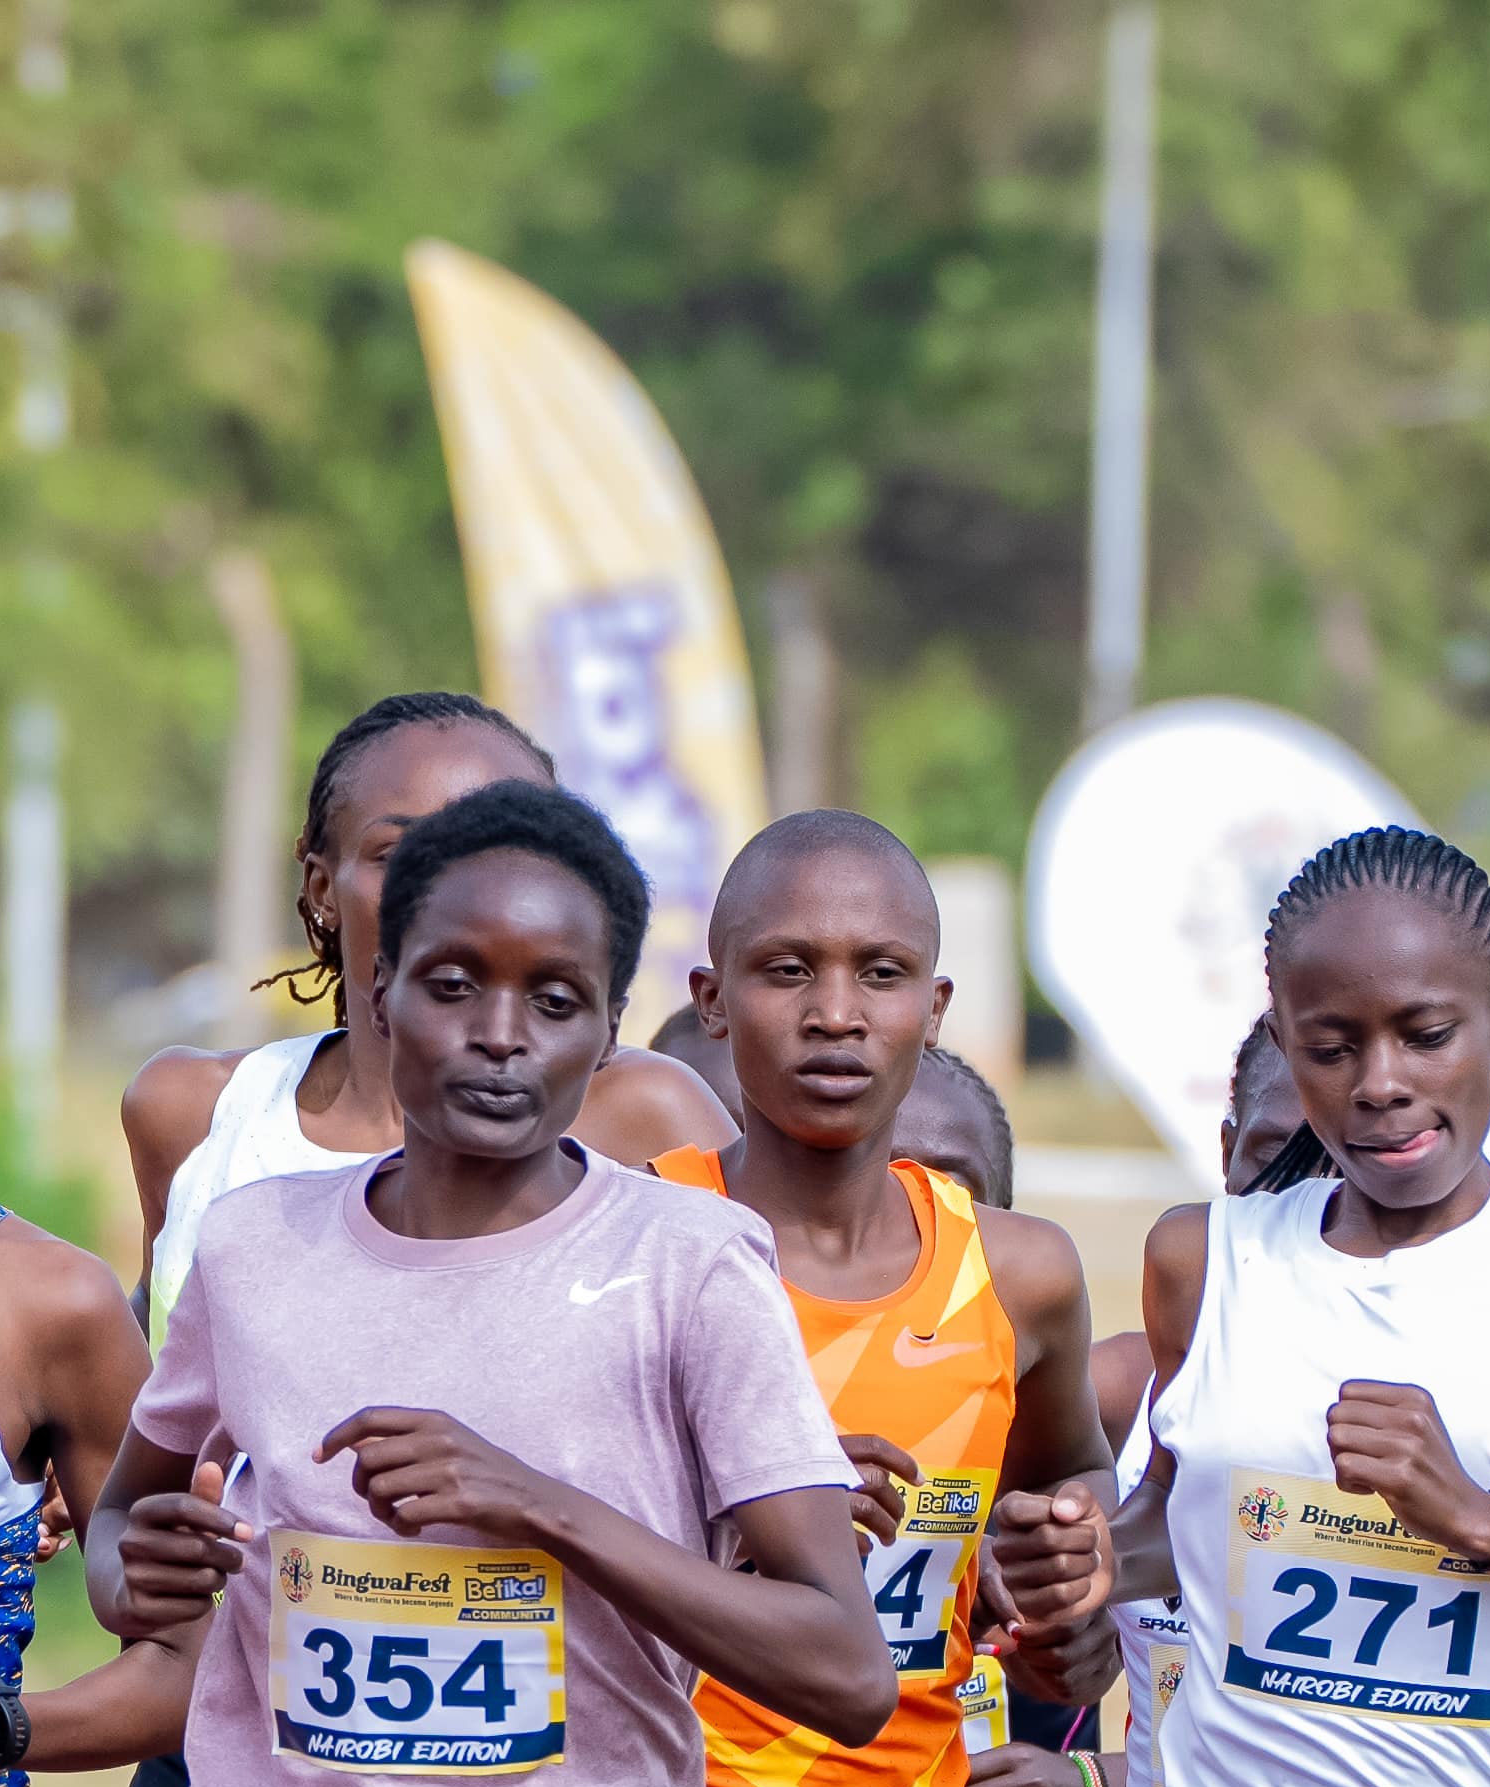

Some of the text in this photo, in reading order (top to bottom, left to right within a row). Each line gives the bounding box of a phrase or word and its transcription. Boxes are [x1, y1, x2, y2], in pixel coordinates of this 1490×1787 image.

[917, 1491, 979, 1514] Betika!
[1299, 1504, 1423, 1540] BingwaF
[1314, 1532, 1335, 1541] Where
[1336, 1534, 1346, 1543] the
[1347, 1536, 1361, 1546] best
[1362, 1538, 1375, 1548] rise
[1384, 1543, 1409, 1553] become
[321, 1565, 452, 1594] BingwaFest
[465, 1575, 545, 1601] Betika!
[861, 1549, 933, 1629] 4
[334, 1593, 352, 1601] Where
[365, 1596, 379, 1604] best
[1265, 1567, 1481, 1676] 271
[303, 1628, 516, 1723] 354
[1260, 1669, 1471, 1715] NAIROBI EDITION
[307, 1733, 513, 1763] NAIROBI EDITION
